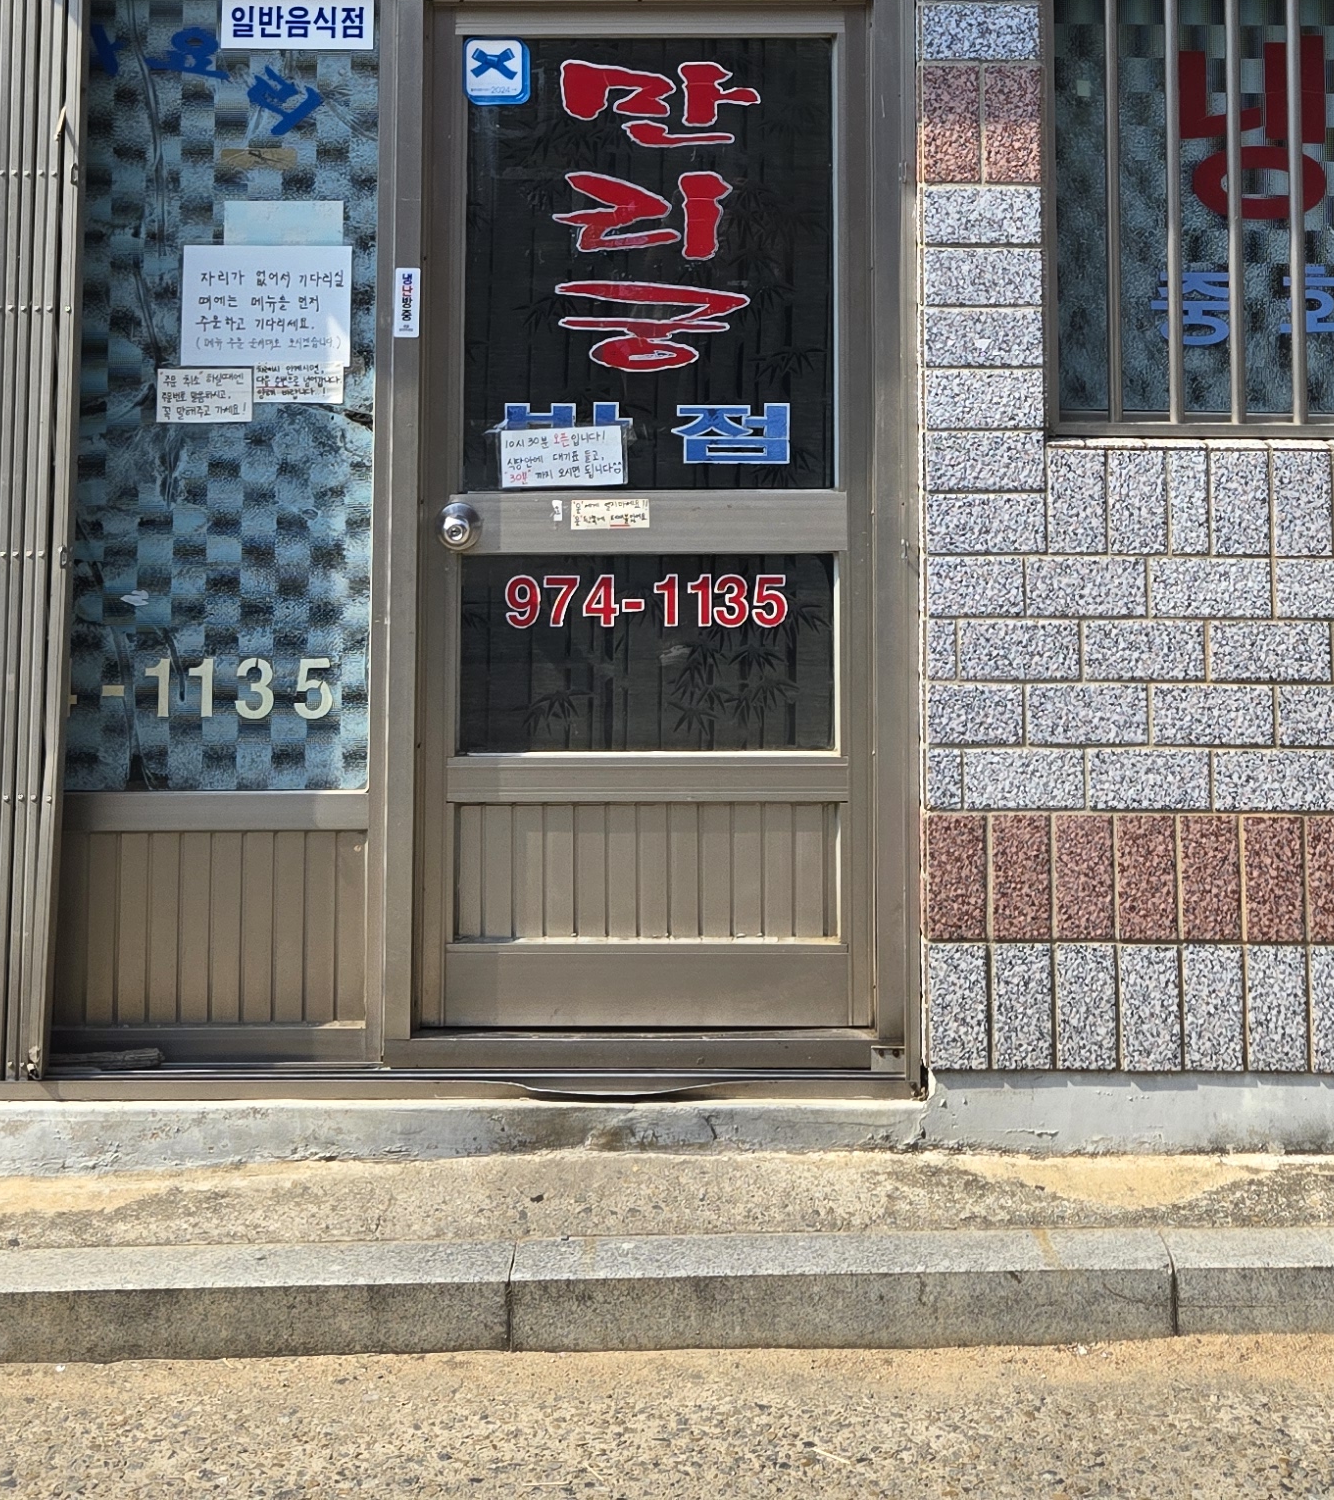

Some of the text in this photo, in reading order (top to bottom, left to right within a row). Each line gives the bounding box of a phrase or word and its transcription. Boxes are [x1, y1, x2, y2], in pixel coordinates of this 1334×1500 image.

[230, 4, 365, 39] 일반음식점
[200, 269, 345, 288] 자리가 없어서 기다리실
[297, 294, 320, 312] 먼저
[402, 272, 414, 322] 냉난방중
[195, 315, 315, 333] 주문하고 기다리세요.
[527, 436, 550, 450] 30분
[505, 573, 788, 629] 974-1135
